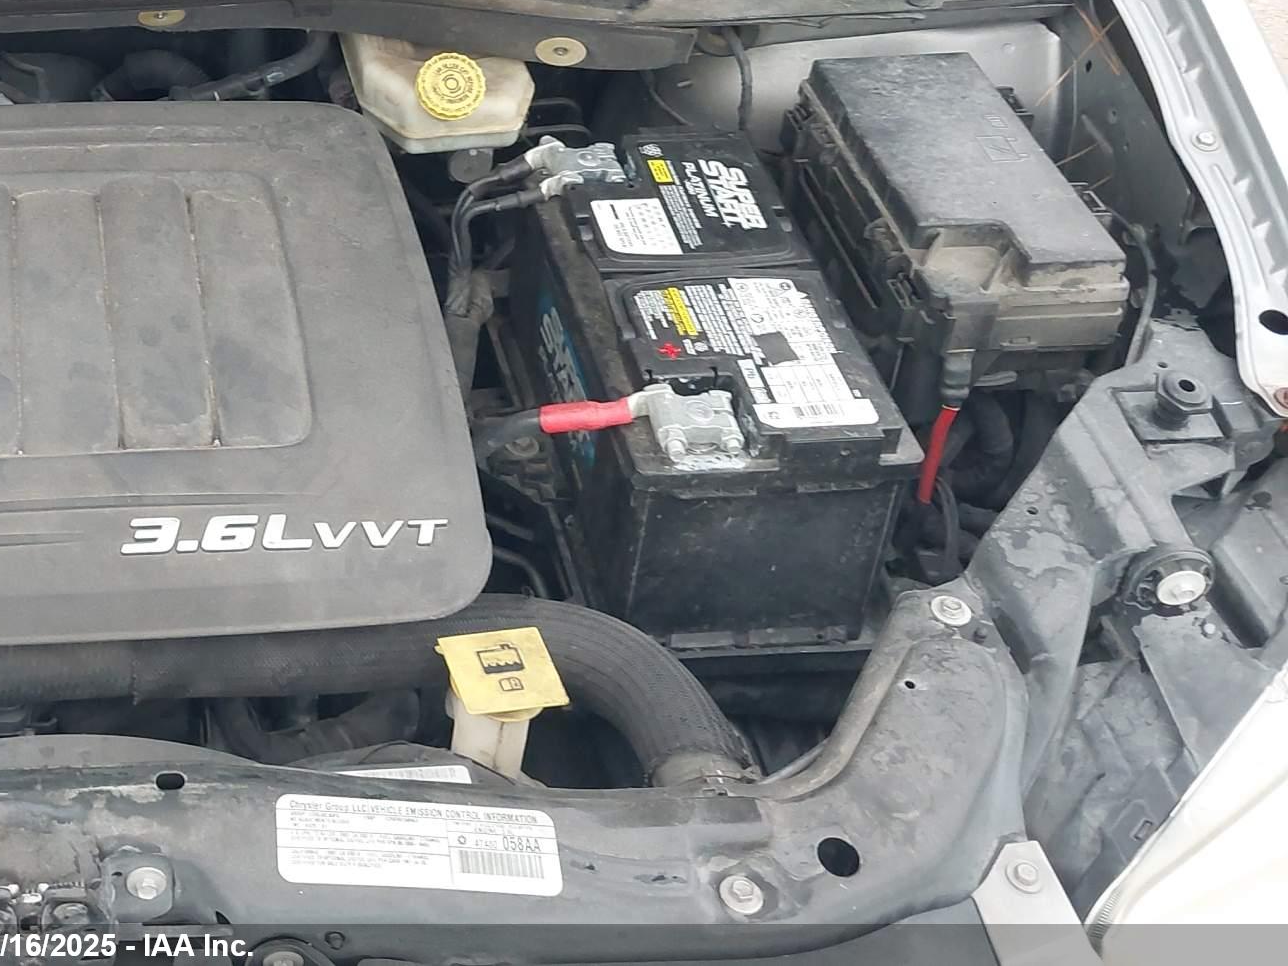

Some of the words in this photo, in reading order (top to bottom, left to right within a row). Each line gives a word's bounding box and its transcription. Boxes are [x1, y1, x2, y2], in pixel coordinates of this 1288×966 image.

[681, 162, 720, 218] PLATINUM
[726, 167, 768, 230] SUPER
[289, 800, 323, 812] Chrysler
[326, 802, 349, 813] Group
[369, 804, 402, 815] VEHICLE
[405, 806, 442, 818] EMISSION
[445, 809, 481, 820] CONTROL
[484, 812, 538, 824] INFORMATION
[502, 836, 541, 852] 058AA
